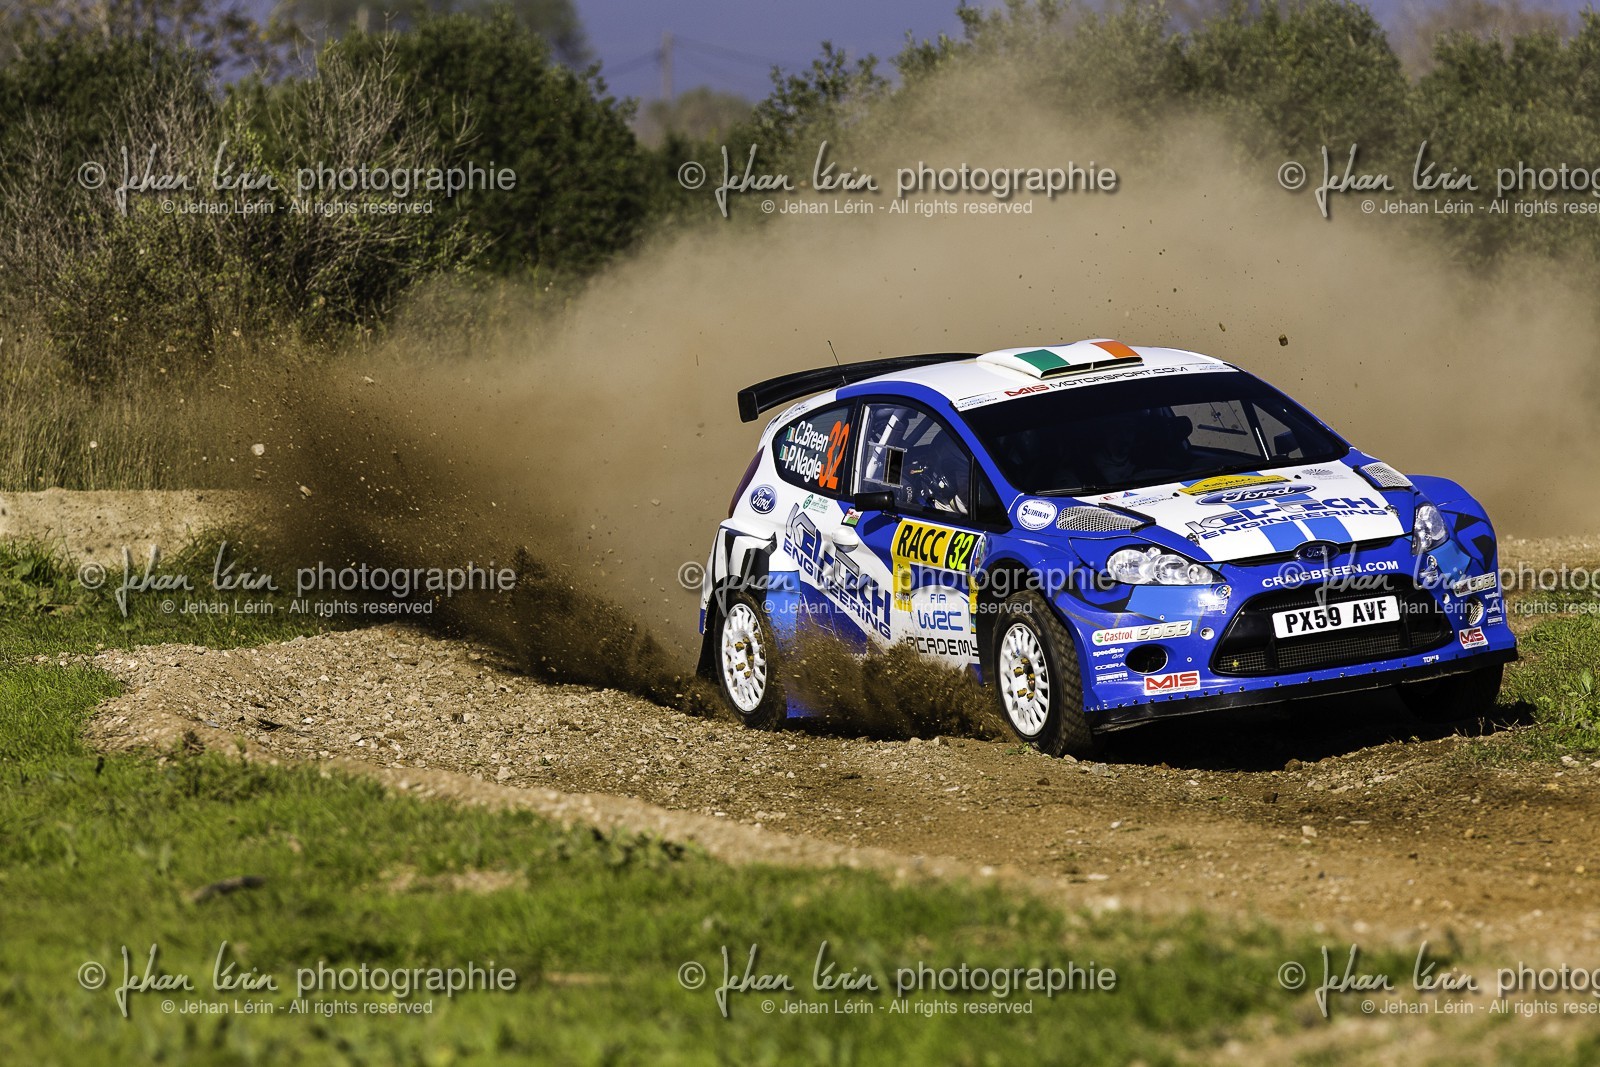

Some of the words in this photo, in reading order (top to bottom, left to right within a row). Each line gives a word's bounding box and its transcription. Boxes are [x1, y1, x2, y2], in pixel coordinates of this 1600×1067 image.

[1004, 384, 1050, 397] MIS
[1050, 366, 1188, 388] MOTORSPORT.COM
[795, 421, 829, 452] C.Breen
[785, 445, 822, 483] P.Nagle
[819, 421, 850, 489] 32
[752, 486, 772, 511] Ford
[1221, 485, 1296, 502] Ford
[1185, 497, 1380, 534] KEL-TECH
[1201, 509, 1388, 540] ENGINEERING
[897, 524, 947, 563] RACC
[949, 533, 975, 572] 32
[783, 537, 891, 640] ENGINEERING
[1262, 560, 1399, 588] CRAIGBREEN.COM
[930, 594, 947, 603] FIA
[1103, 630, 1132, 643] Castrol
[1137, 621, 1191, 640] EDGE
[1285, 607, 1342, 634] PX59
[1353, 600, 1387, 623] AVF
[1095, 662, 1126, 670] COBRA
[1146, 673, 1198, 690] MIS
